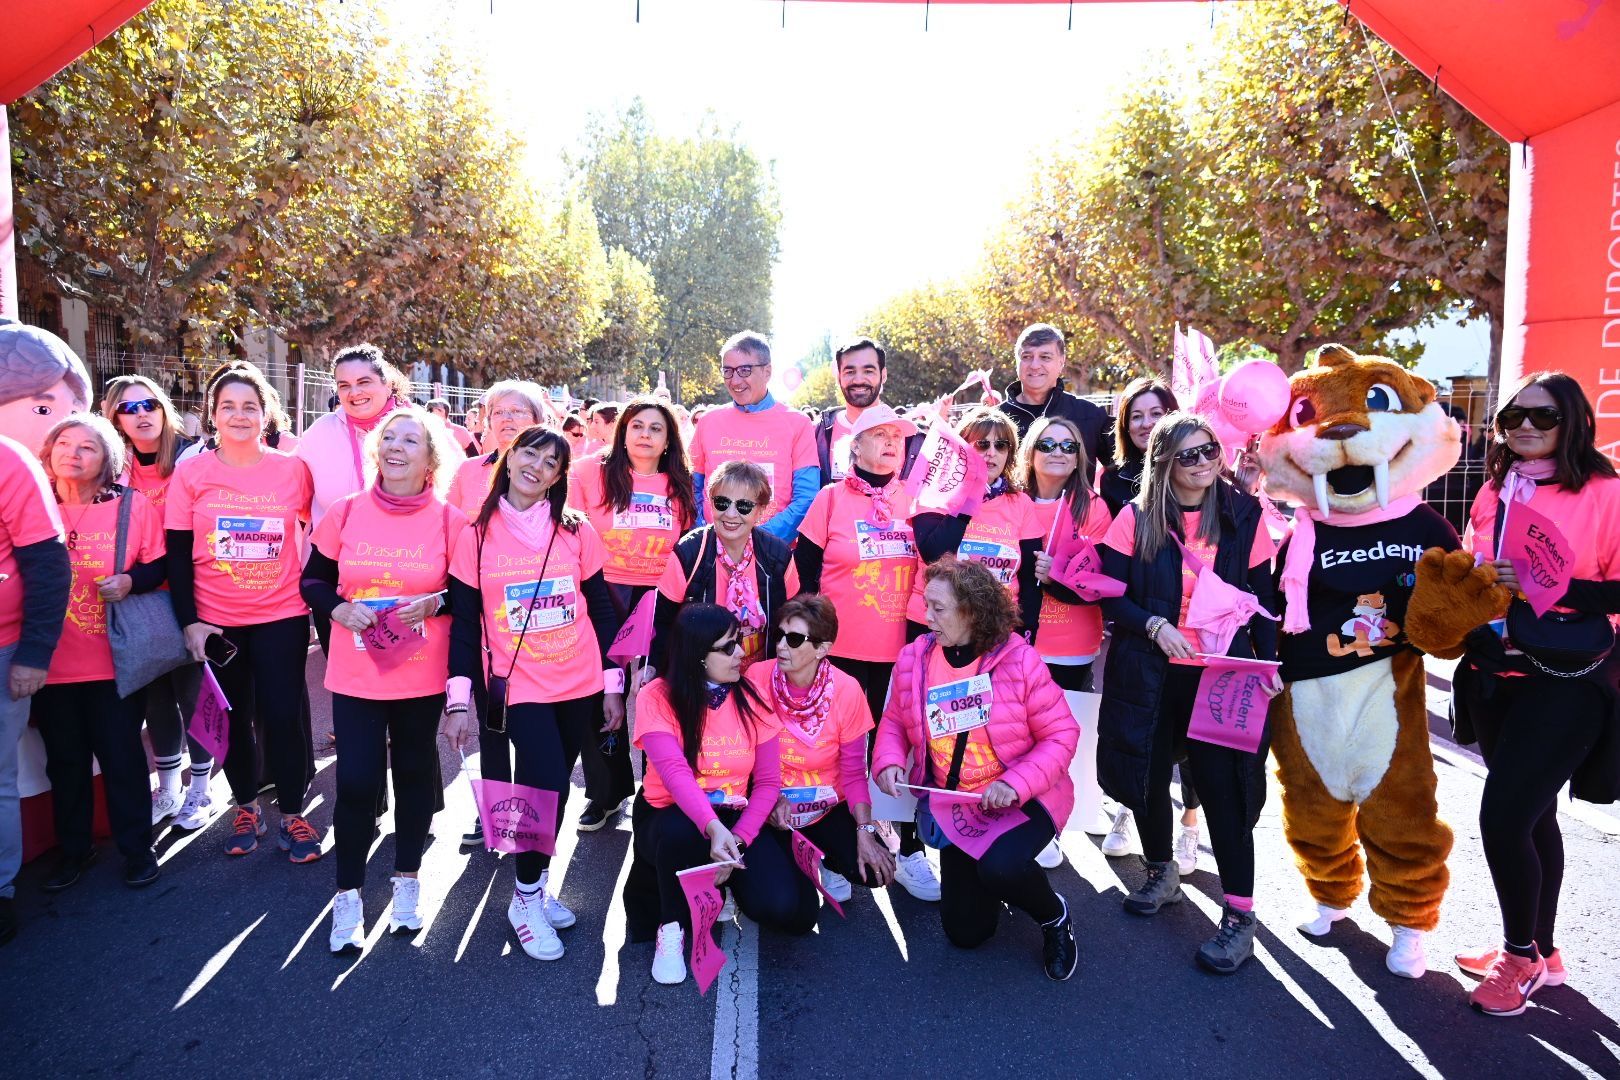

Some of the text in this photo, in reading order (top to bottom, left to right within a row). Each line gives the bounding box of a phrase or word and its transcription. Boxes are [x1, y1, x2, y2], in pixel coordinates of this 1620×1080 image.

[218, 489, 277, 503] Drasanvi
[635, 503, 661, 512] 5103
[235, 532, 283, 542] MADRINA
[880, 531, 908, 541] 5626
[356, 542, 425, 559] Drasanvi
[1320, 541, 1424, 569] Ezedent
[980, 556, 1010, 568] 6000
[533, 594, 565, 611] 5772
[950, 694, 983, 711] 0326
[1234, 673, 1261, 731] Ezedent
[797, 800, 828, 814] 0760
